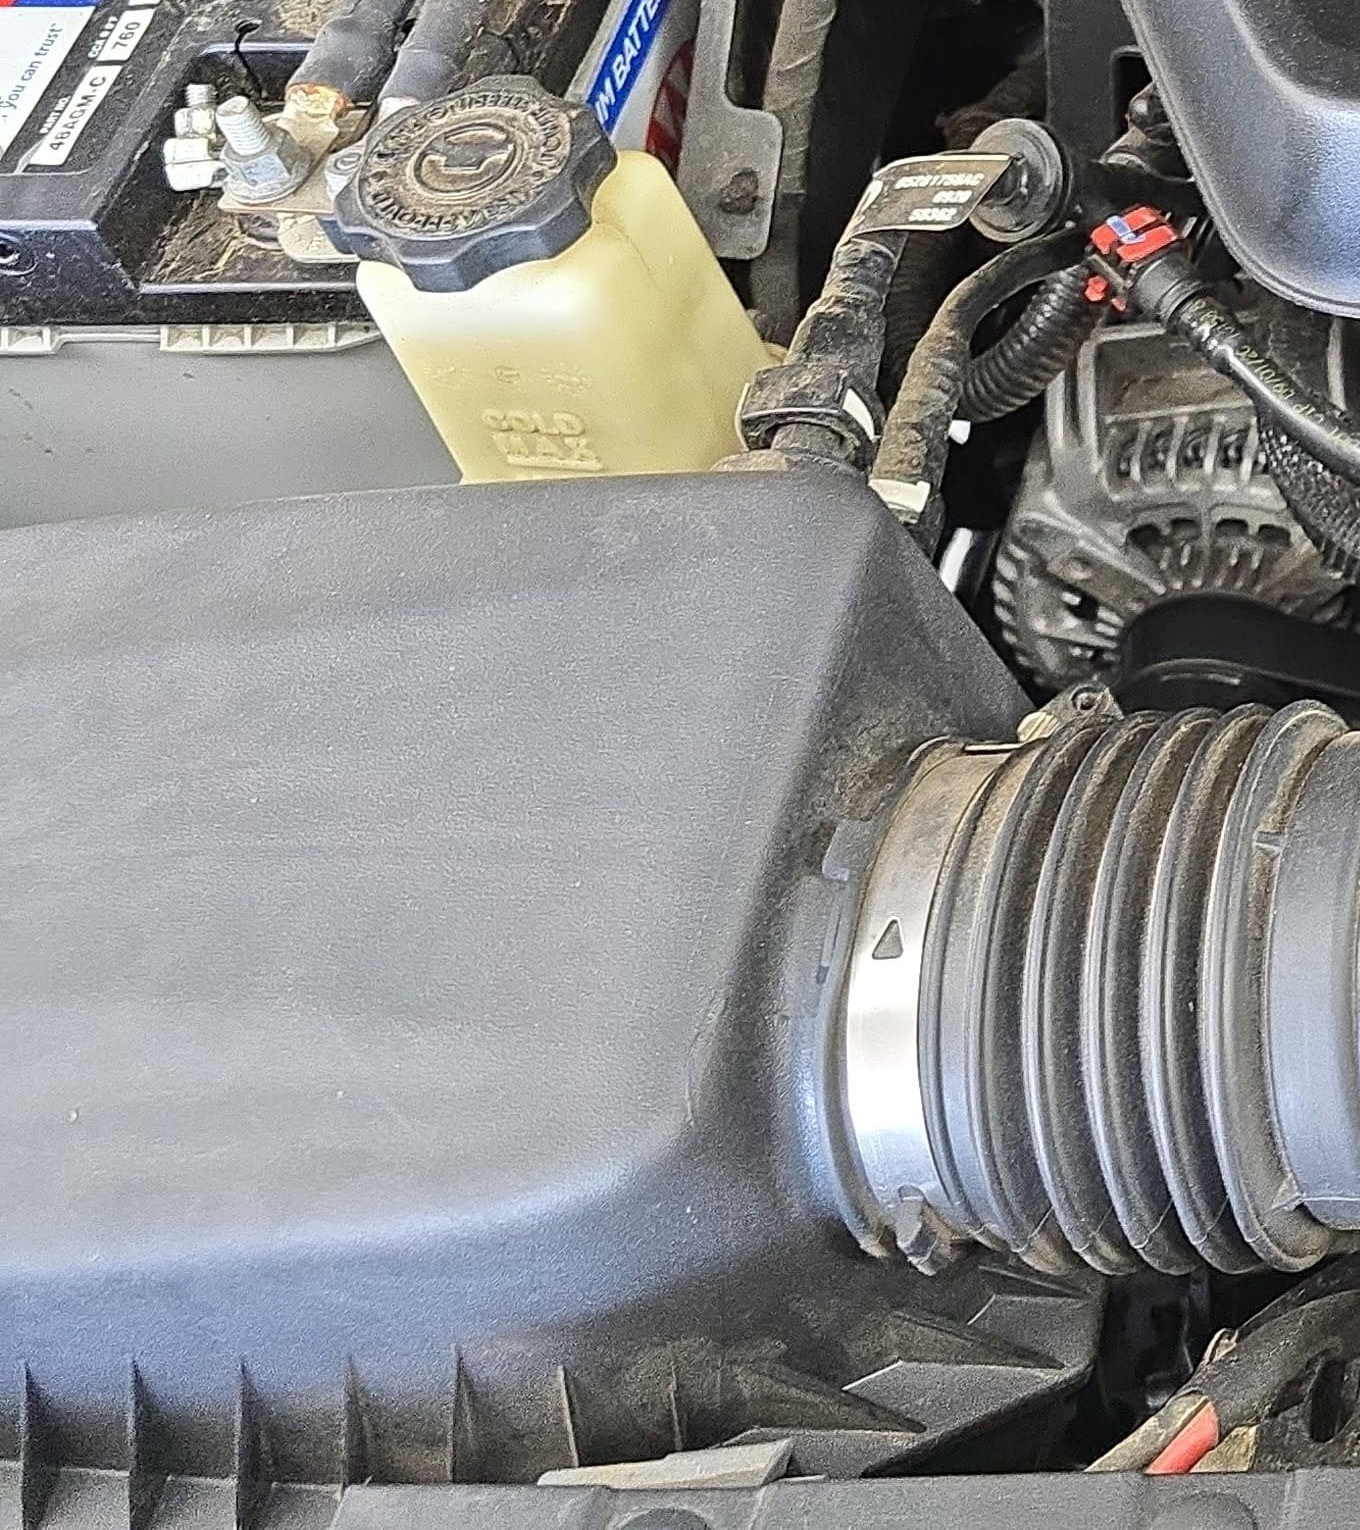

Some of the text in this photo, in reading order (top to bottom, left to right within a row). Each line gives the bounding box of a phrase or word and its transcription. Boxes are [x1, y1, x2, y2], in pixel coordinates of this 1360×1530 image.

[107, 20, 144, 50] 760
[0, 82, 33, 111] you
[17, 59, 44, 81] can
[482, 408, 586, 437] COLD
[490, 431, 600, 463] MAX
